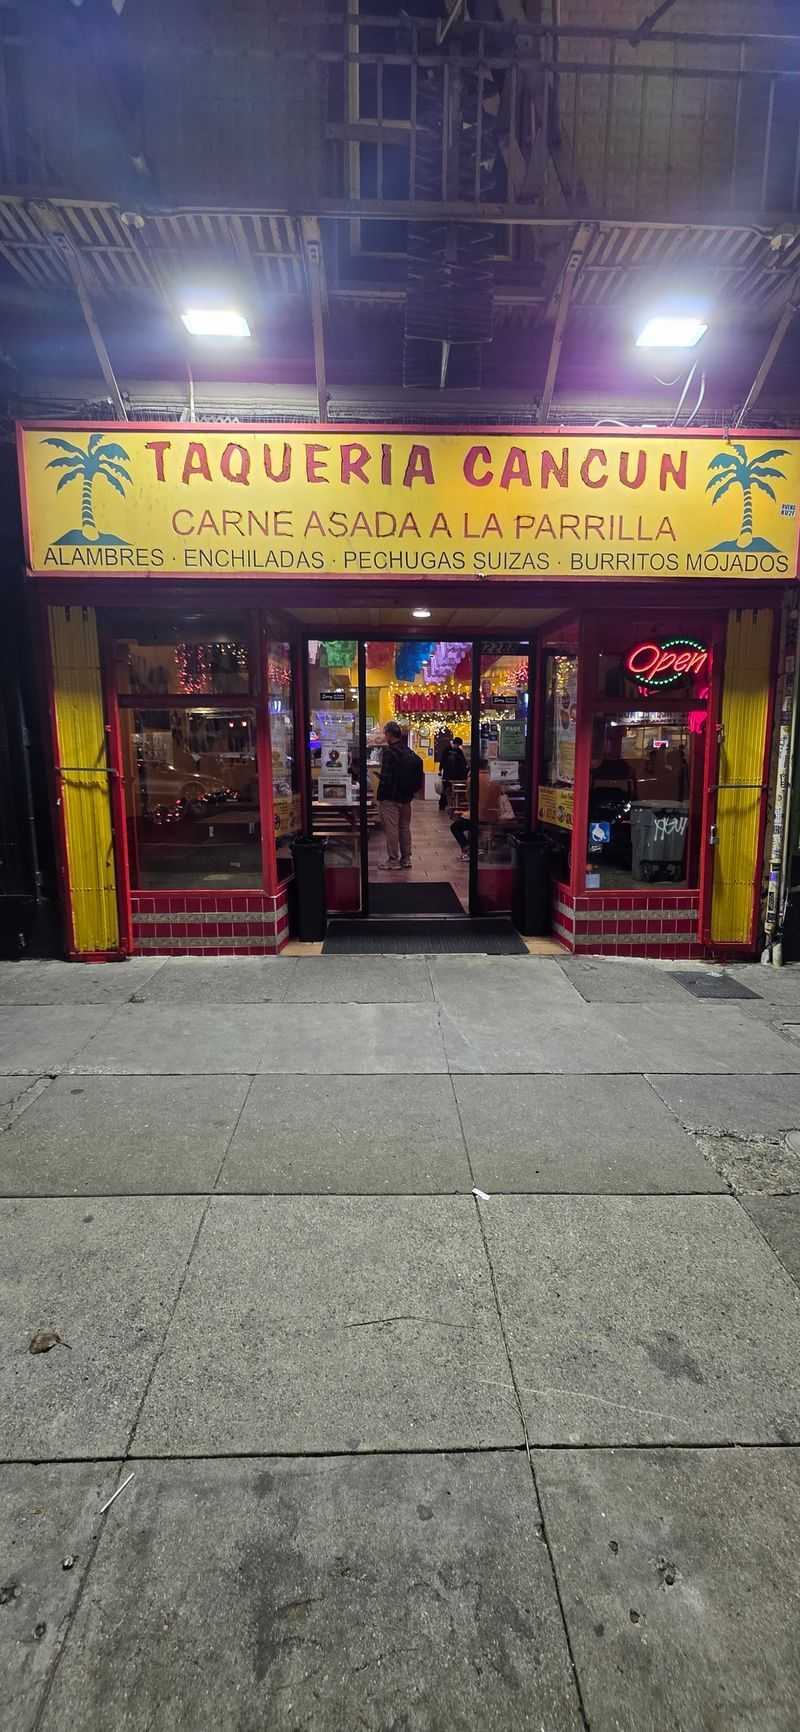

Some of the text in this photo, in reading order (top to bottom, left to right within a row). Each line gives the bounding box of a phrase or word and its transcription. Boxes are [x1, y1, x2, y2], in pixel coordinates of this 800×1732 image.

[144, 440, 688, 491] TAQUERIA CANCUN
[171, 509, 677, 542] CARNE ASADA A LA PARRILLA
[43, 547, 789, 573] ALAMBRES ENCHILADAS PECHUGAS SUIZAS BURRITOS MOJADOS
[628, 645, 708, 681] Open
